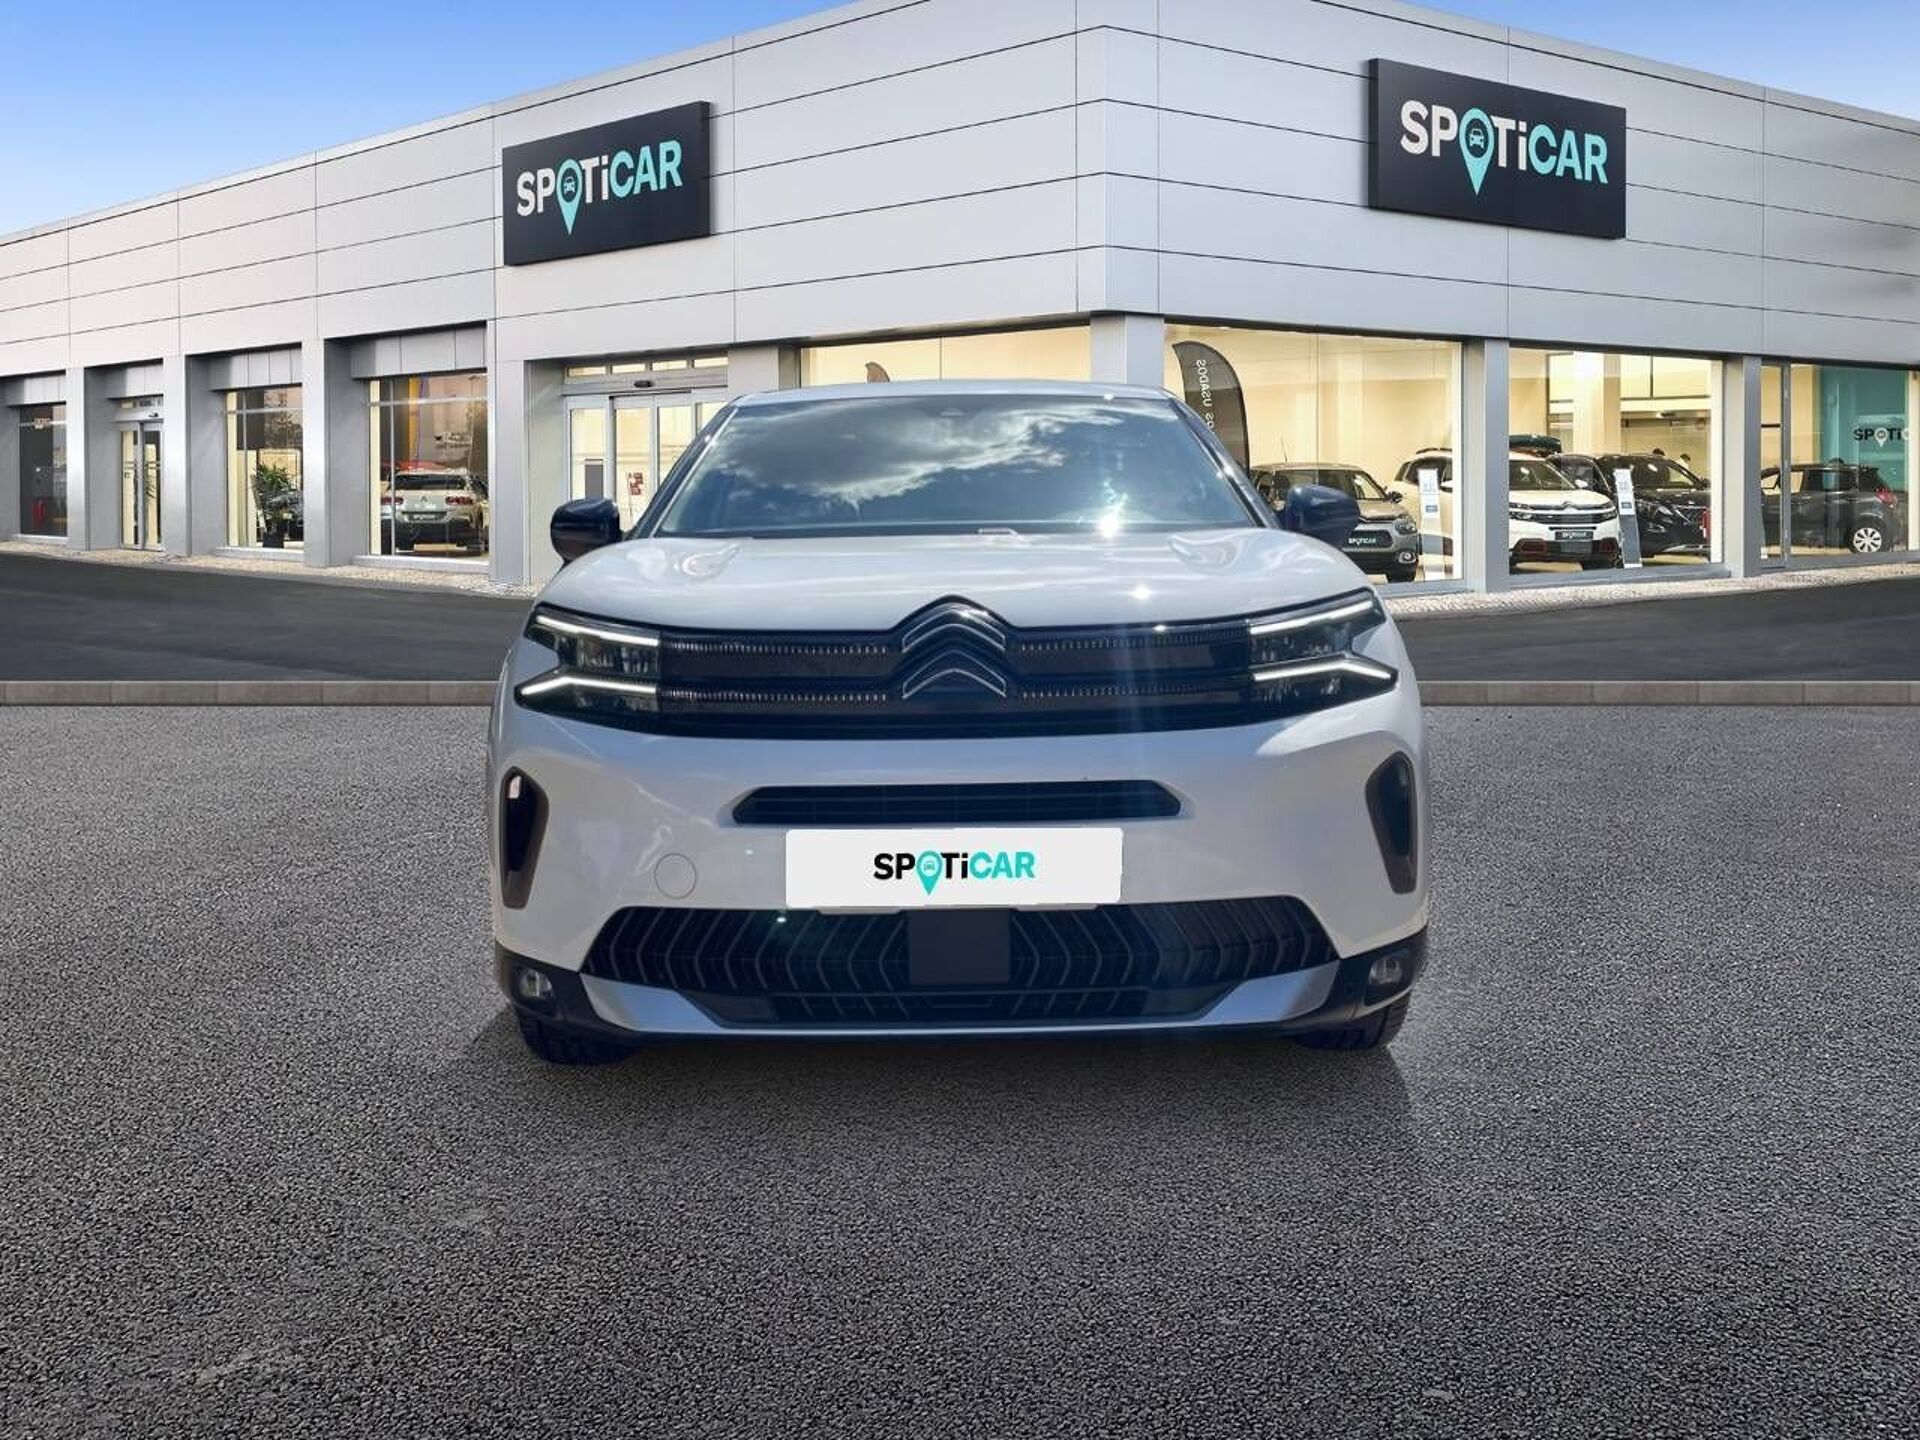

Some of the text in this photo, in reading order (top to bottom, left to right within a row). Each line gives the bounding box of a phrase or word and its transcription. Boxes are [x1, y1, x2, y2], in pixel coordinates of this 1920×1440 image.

[516, 140, 683, 235] SPOTiCAR
[1400, 100, 1608, 196] SPOTiCAR
[873, 850, 1036, 896] SPOTiCAR
